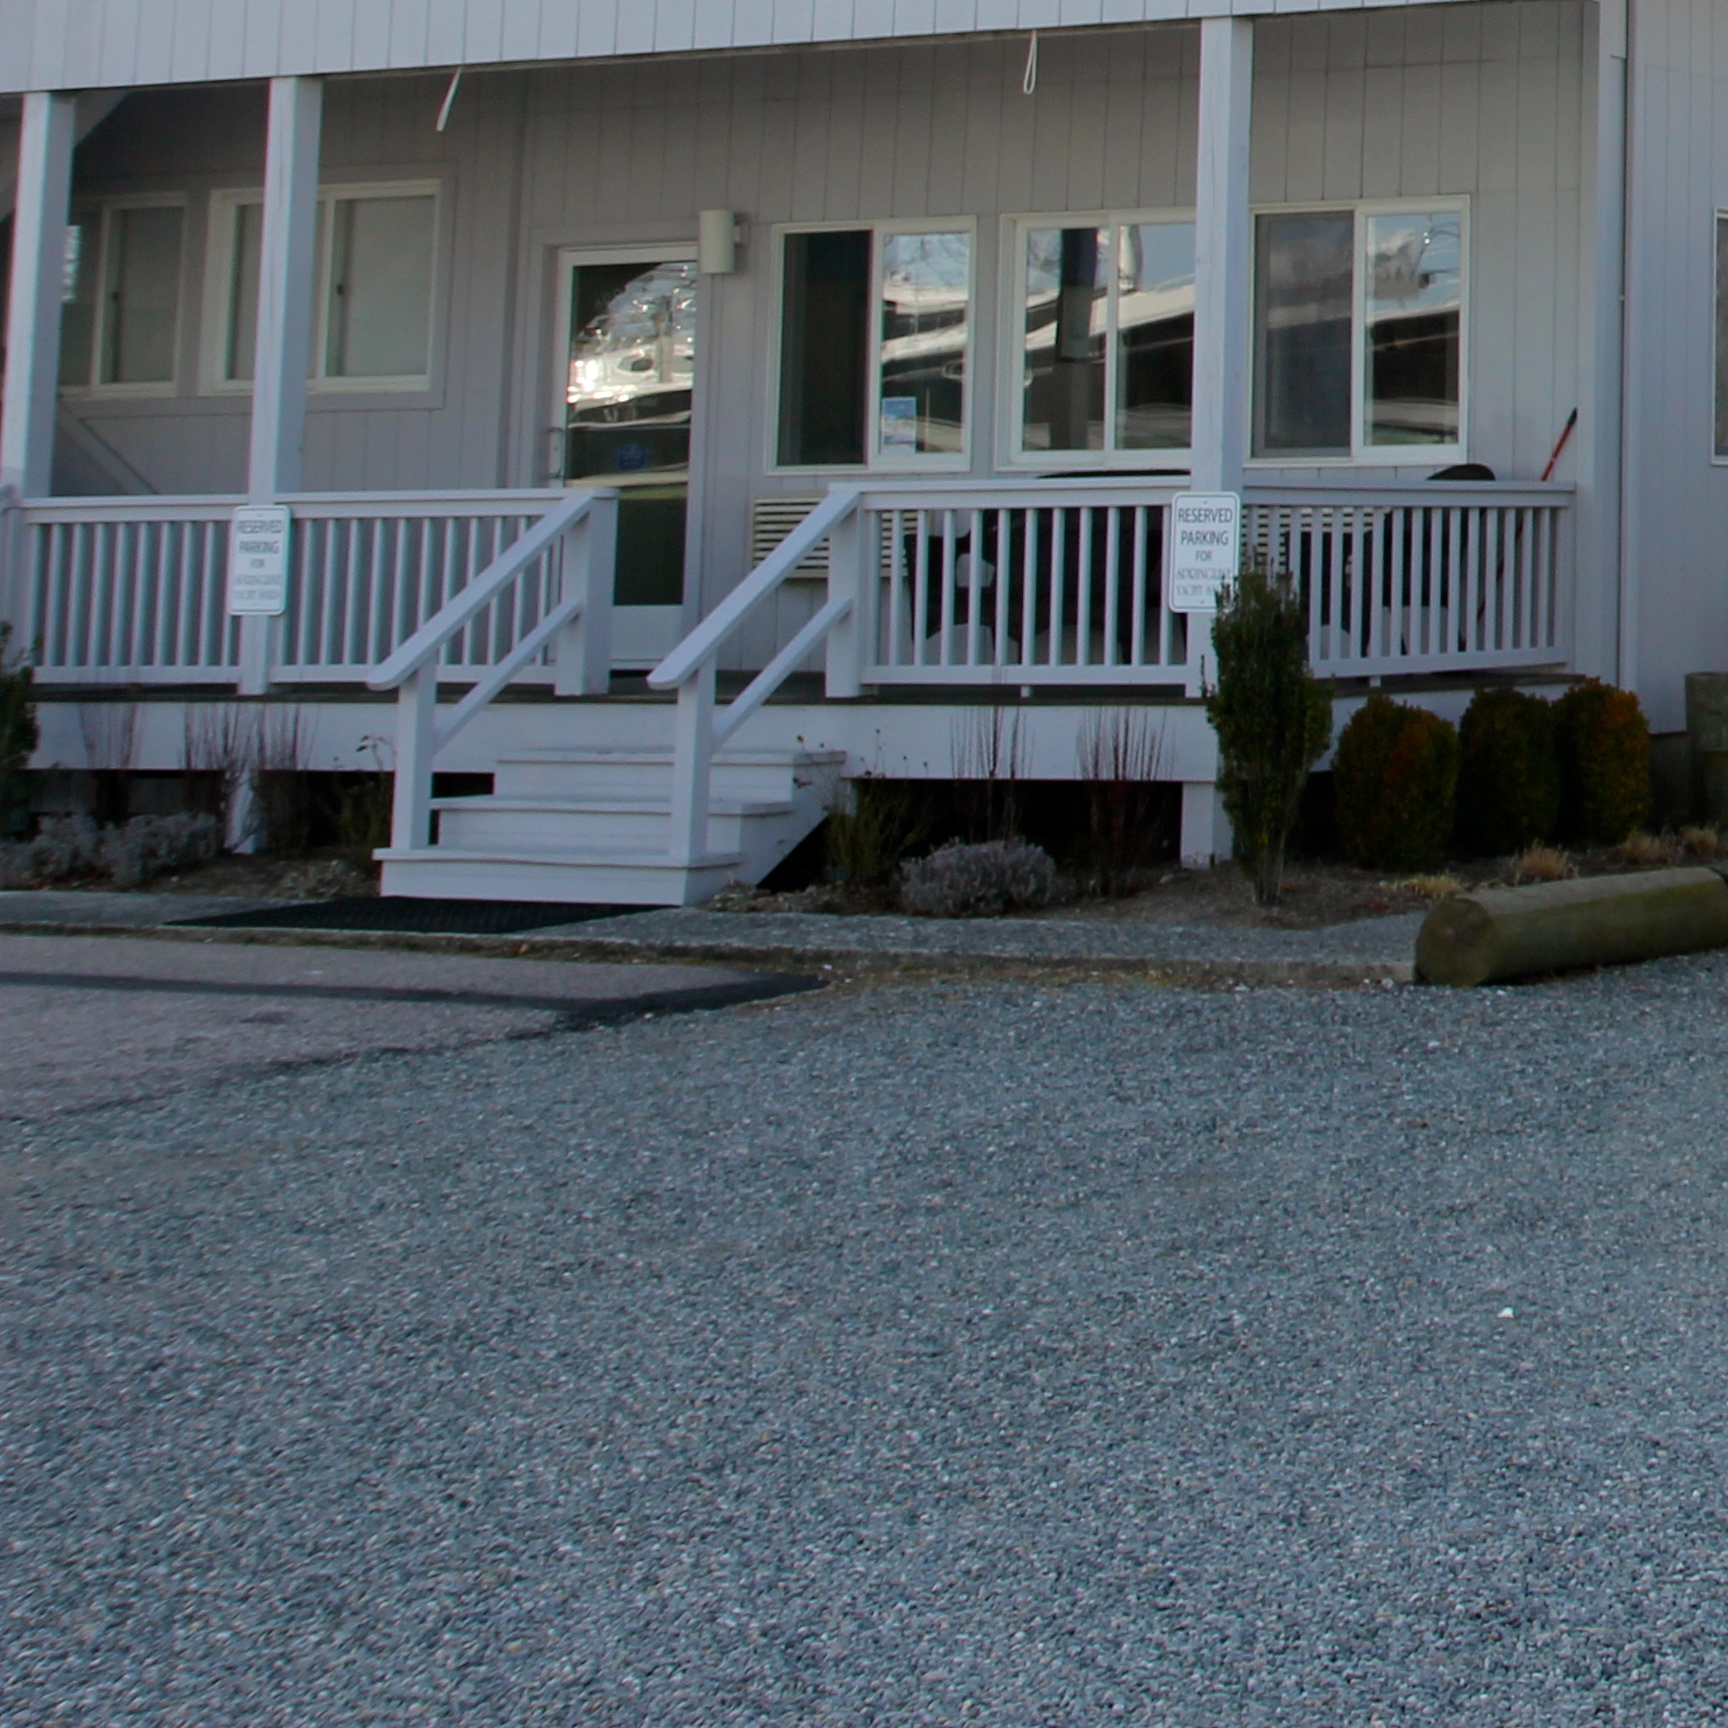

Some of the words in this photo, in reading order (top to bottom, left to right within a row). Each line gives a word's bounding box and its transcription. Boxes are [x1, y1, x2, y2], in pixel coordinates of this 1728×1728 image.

[1178, 507, 1233, 523] RESERVED
[1181, 530, 1229, 546] PARKING
[1195, 550, 1212, 562] FOR
